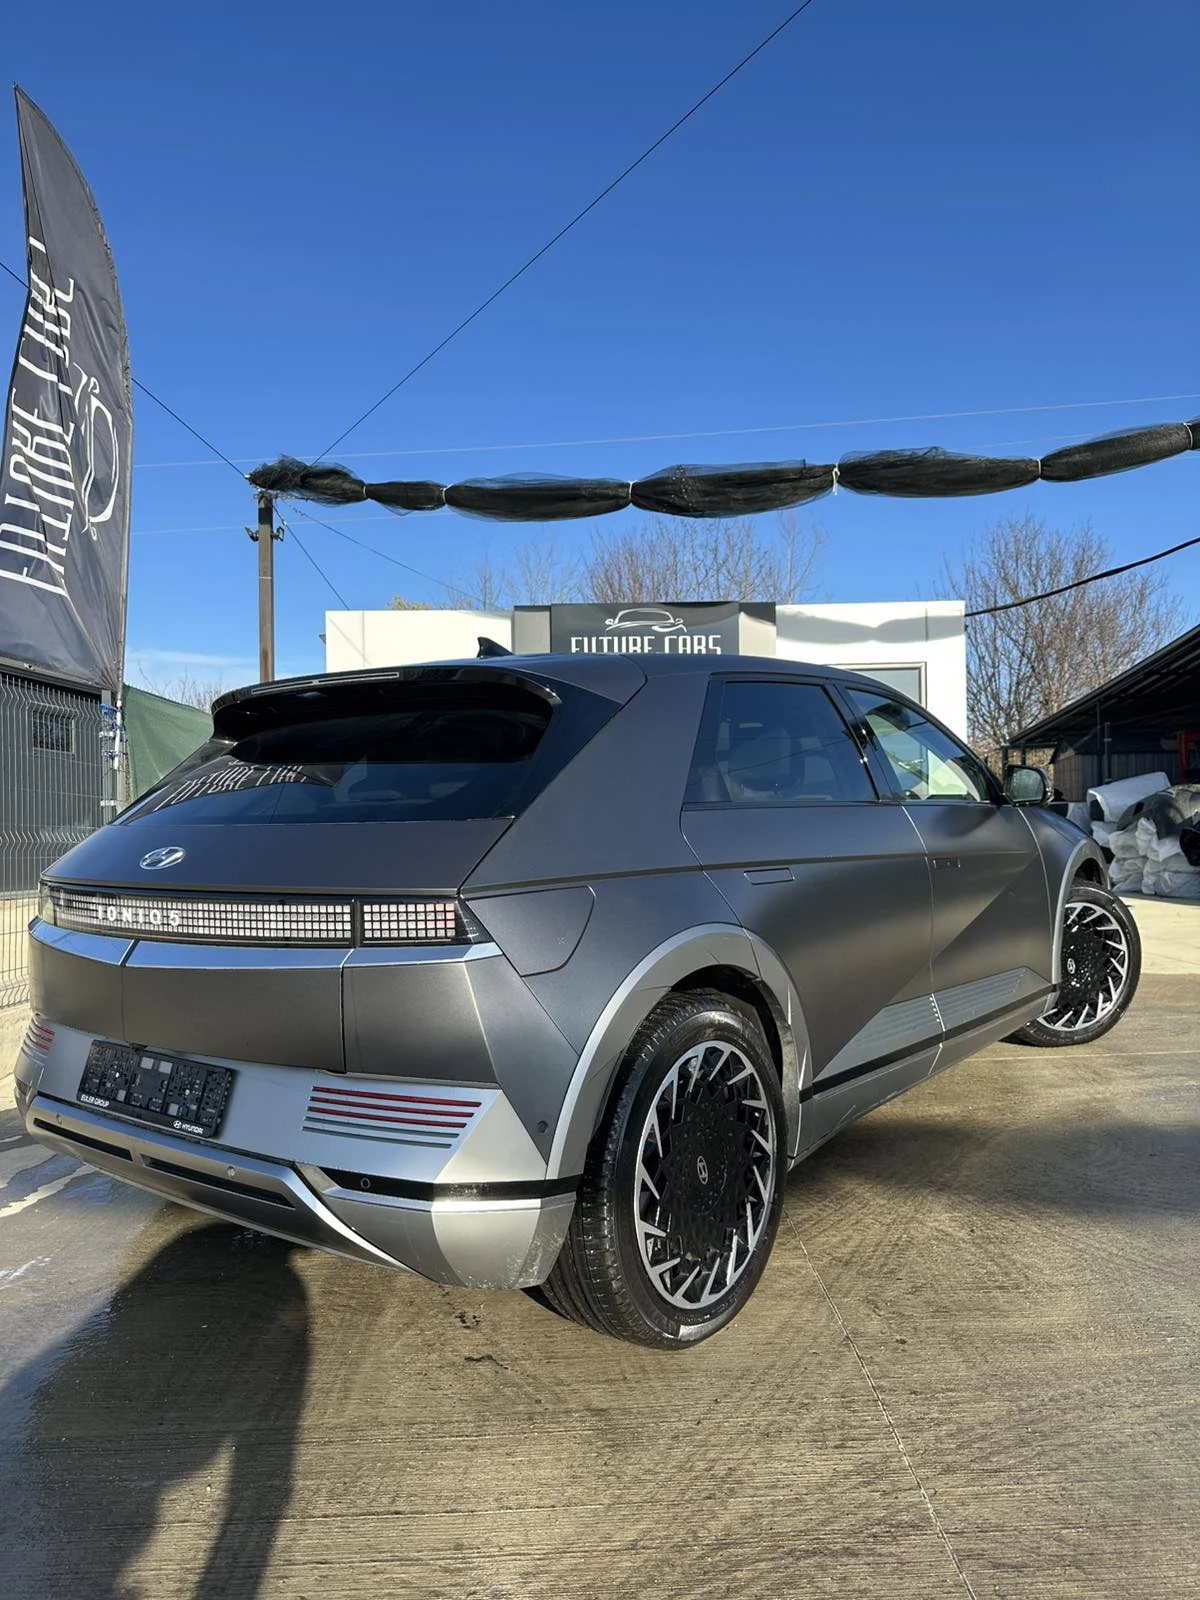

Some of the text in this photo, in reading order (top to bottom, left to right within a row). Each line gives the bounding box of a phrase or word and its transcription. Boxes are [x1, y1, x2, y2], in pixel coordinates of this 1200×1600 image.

[570, 634, 722, 655] FUTURE CARS
[97, 905, 181, 926] IONIQ 5
[94, 1097, 110, 1107] GROUP
[181, 1123, 204, 1135] HYUNDAI
